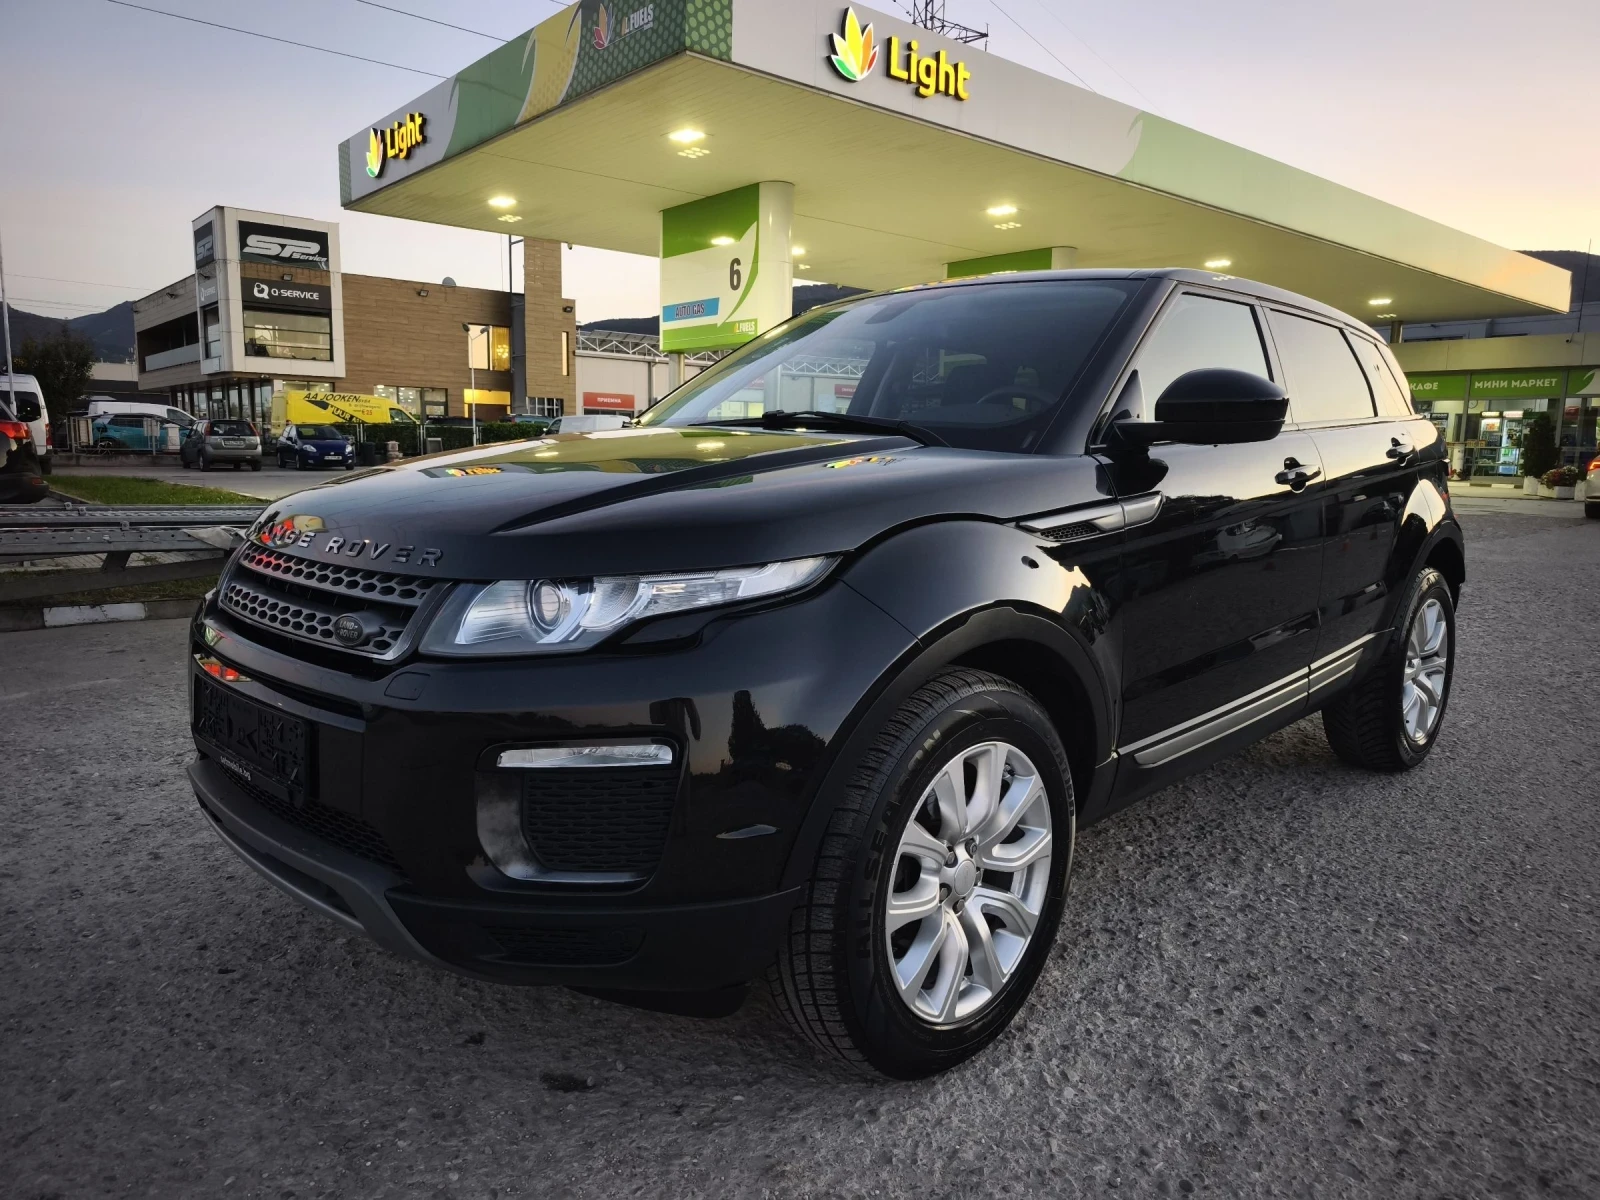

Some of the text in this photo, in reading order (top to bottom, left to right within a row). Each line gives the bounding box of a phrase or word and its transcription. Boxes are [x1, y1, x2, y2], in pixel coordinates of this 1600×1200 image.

[887, 35, 971, 101] Light
[386, 112, 425, 159] Light
[242, 234, 321, 258] SP
[291, 252, 328, 262] Service
[729, 257, 742, 292] 6
[675, 302, 705, 318] AUTO GAS
[1409, 378, 1558, 391] КАФЕ МИНИ МАРКЕТ
[303, 392, 319, 400] AA
[320, 393, 361, 403] JOOKEN
[325, 536, 443, 568] ROVER
